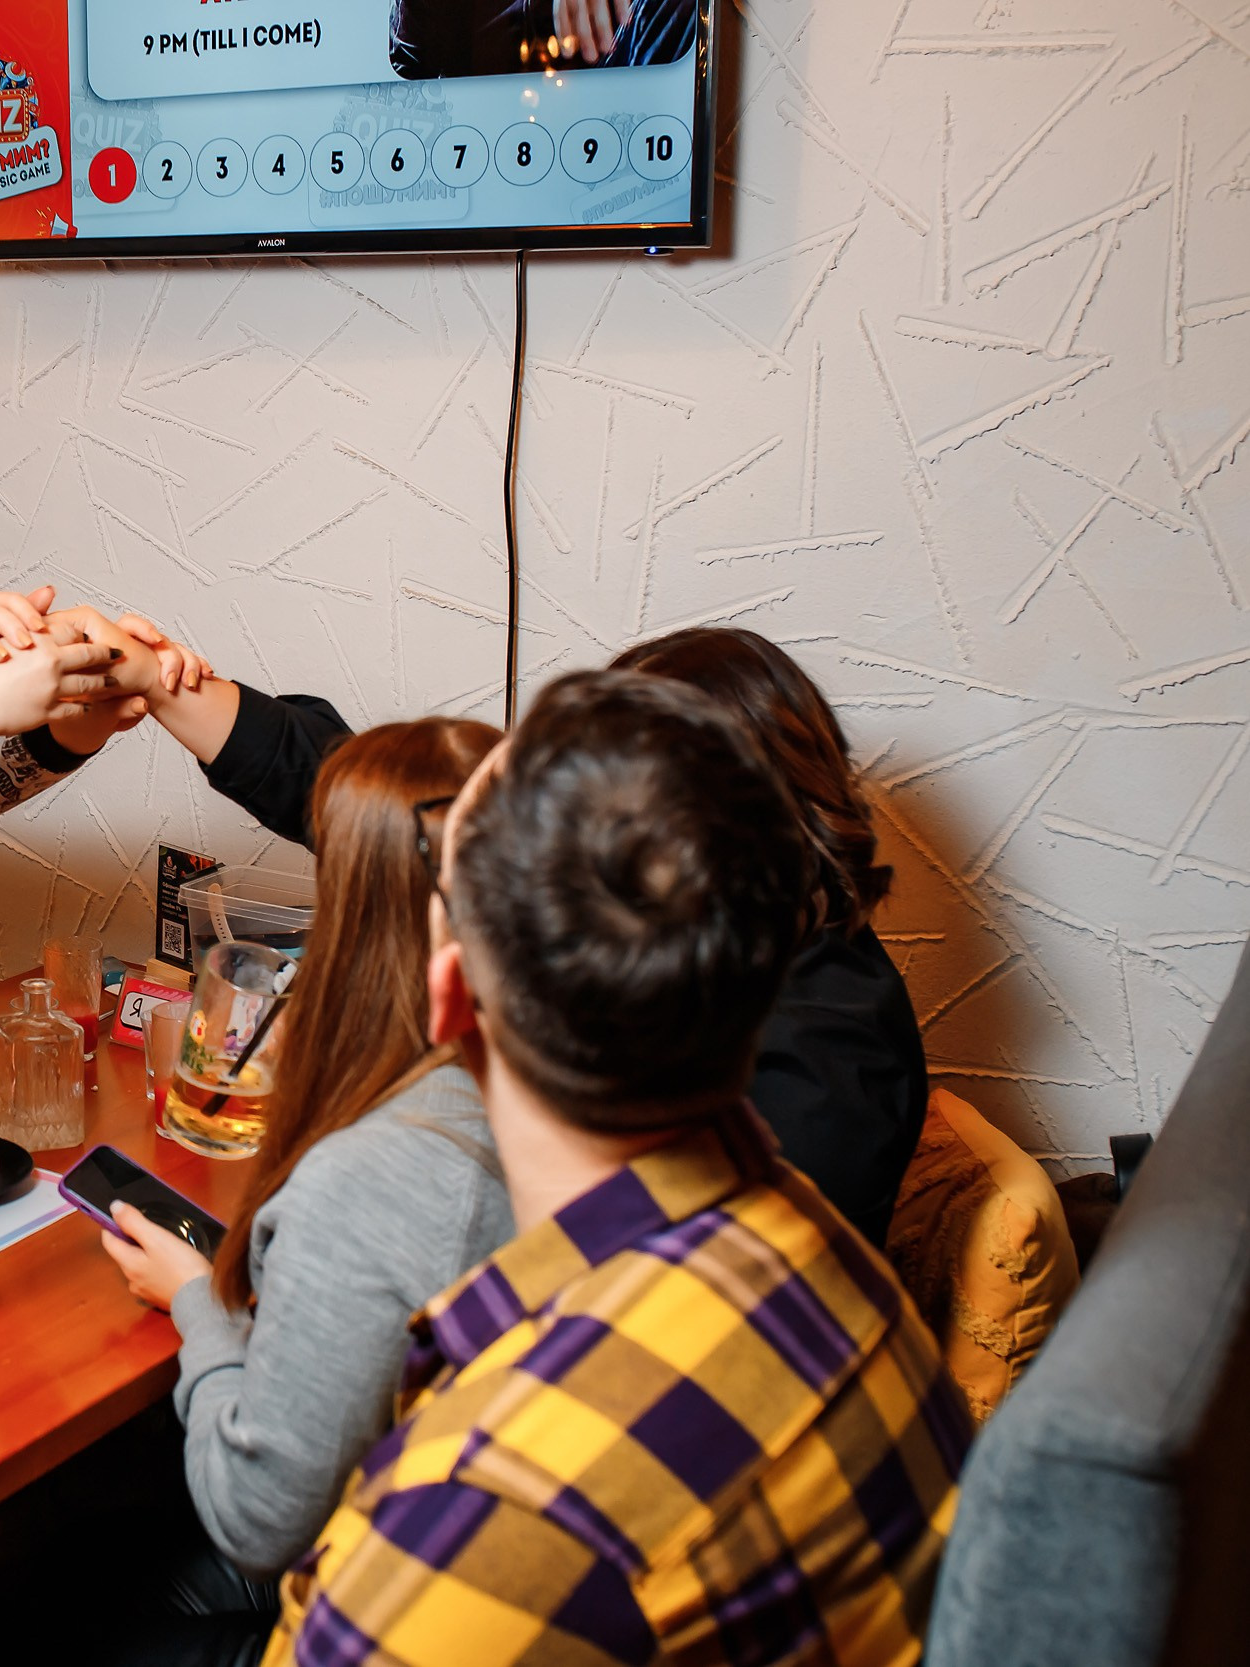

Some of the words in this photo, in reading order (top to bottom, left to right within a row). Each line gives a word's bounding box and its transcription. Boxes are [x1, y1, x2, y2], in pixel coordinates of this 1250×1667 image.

[142, 35, 154, 55] 9
[159, 32, 188, 54] PM
[192, 27, 238, 57] (TILL
[242, 26, 248, 47] I
[253, 19, 322, 48] COME)
[390, 147, 405, 172] 6
[453, 145, 468, 169] 7
[516, 142, 532, 167] 8
[583, 138, 599, 164] 9
[646, 135, 673, 162] 10
[20, 162, 51, 182] GAME
[161, 158, 173, 182] 2
[215, 156, 228, 179] 3
[271, 153, 286, 177] 4
[331, 150, 344, 175] 5
[108, 163, 116, 187] 1
[257, 238, 286, 248] AVALON
